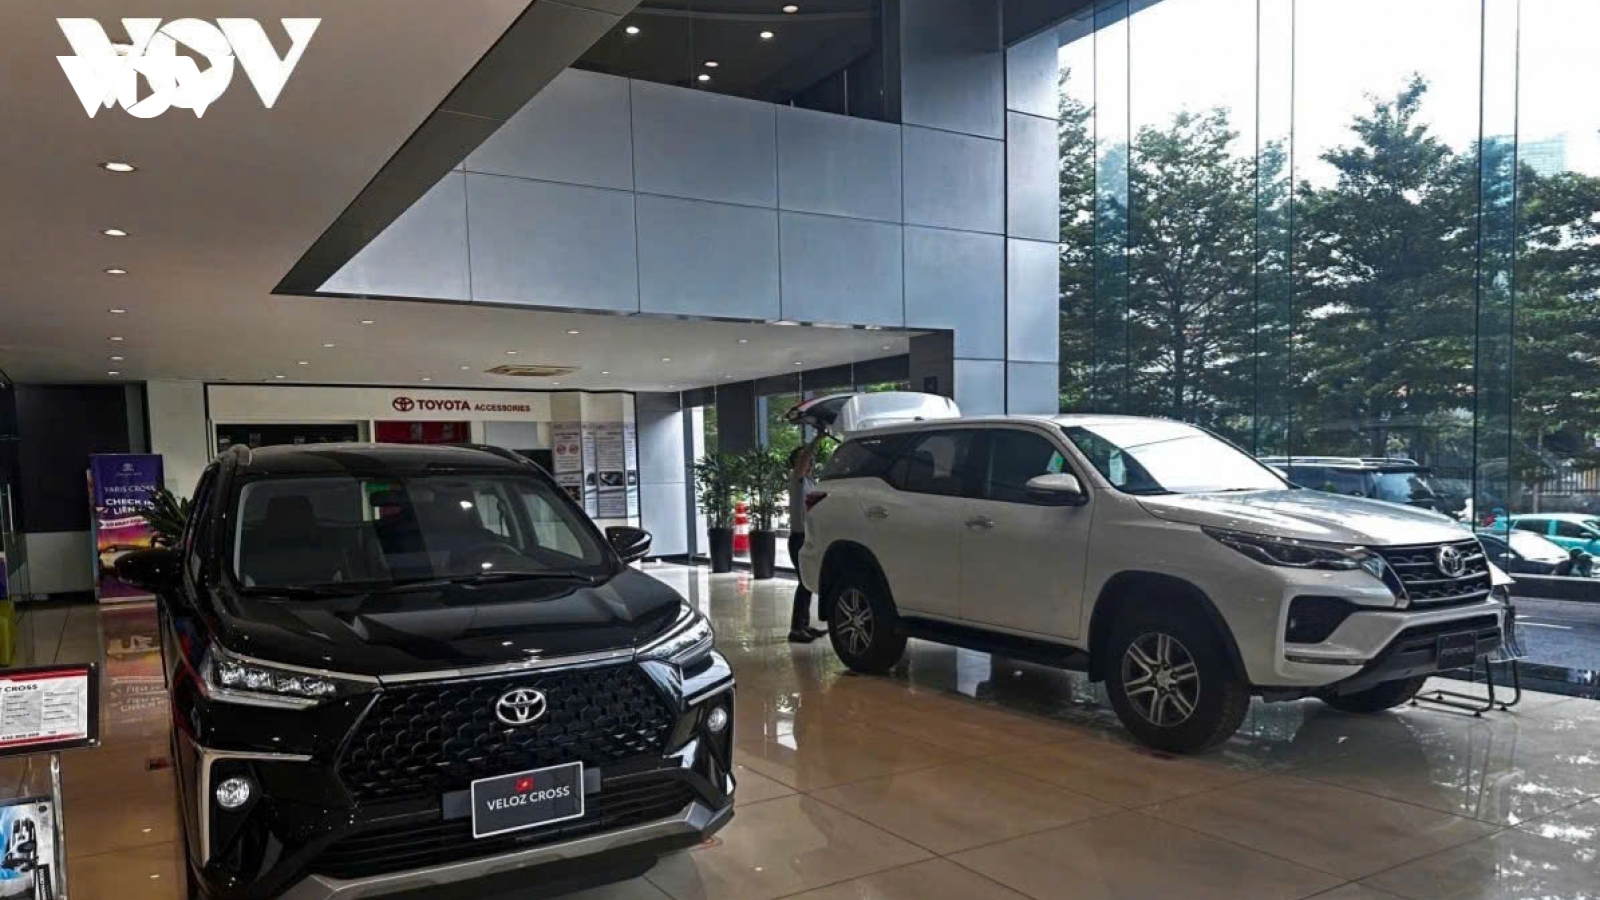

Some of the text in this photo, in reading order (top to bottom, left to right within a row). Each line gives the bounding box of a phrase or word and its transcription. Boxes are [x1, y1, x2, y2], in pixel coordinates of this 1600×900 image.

[415, 399, 531, 413] TOYOTA ACCESSORIES
[103, 485, 127, 493] YARIS
[105, 498, 142, 506] CHECK
[4, 684, 39, 693] CROSS
[486, 785, 571, 811] VELOZ CROSS
